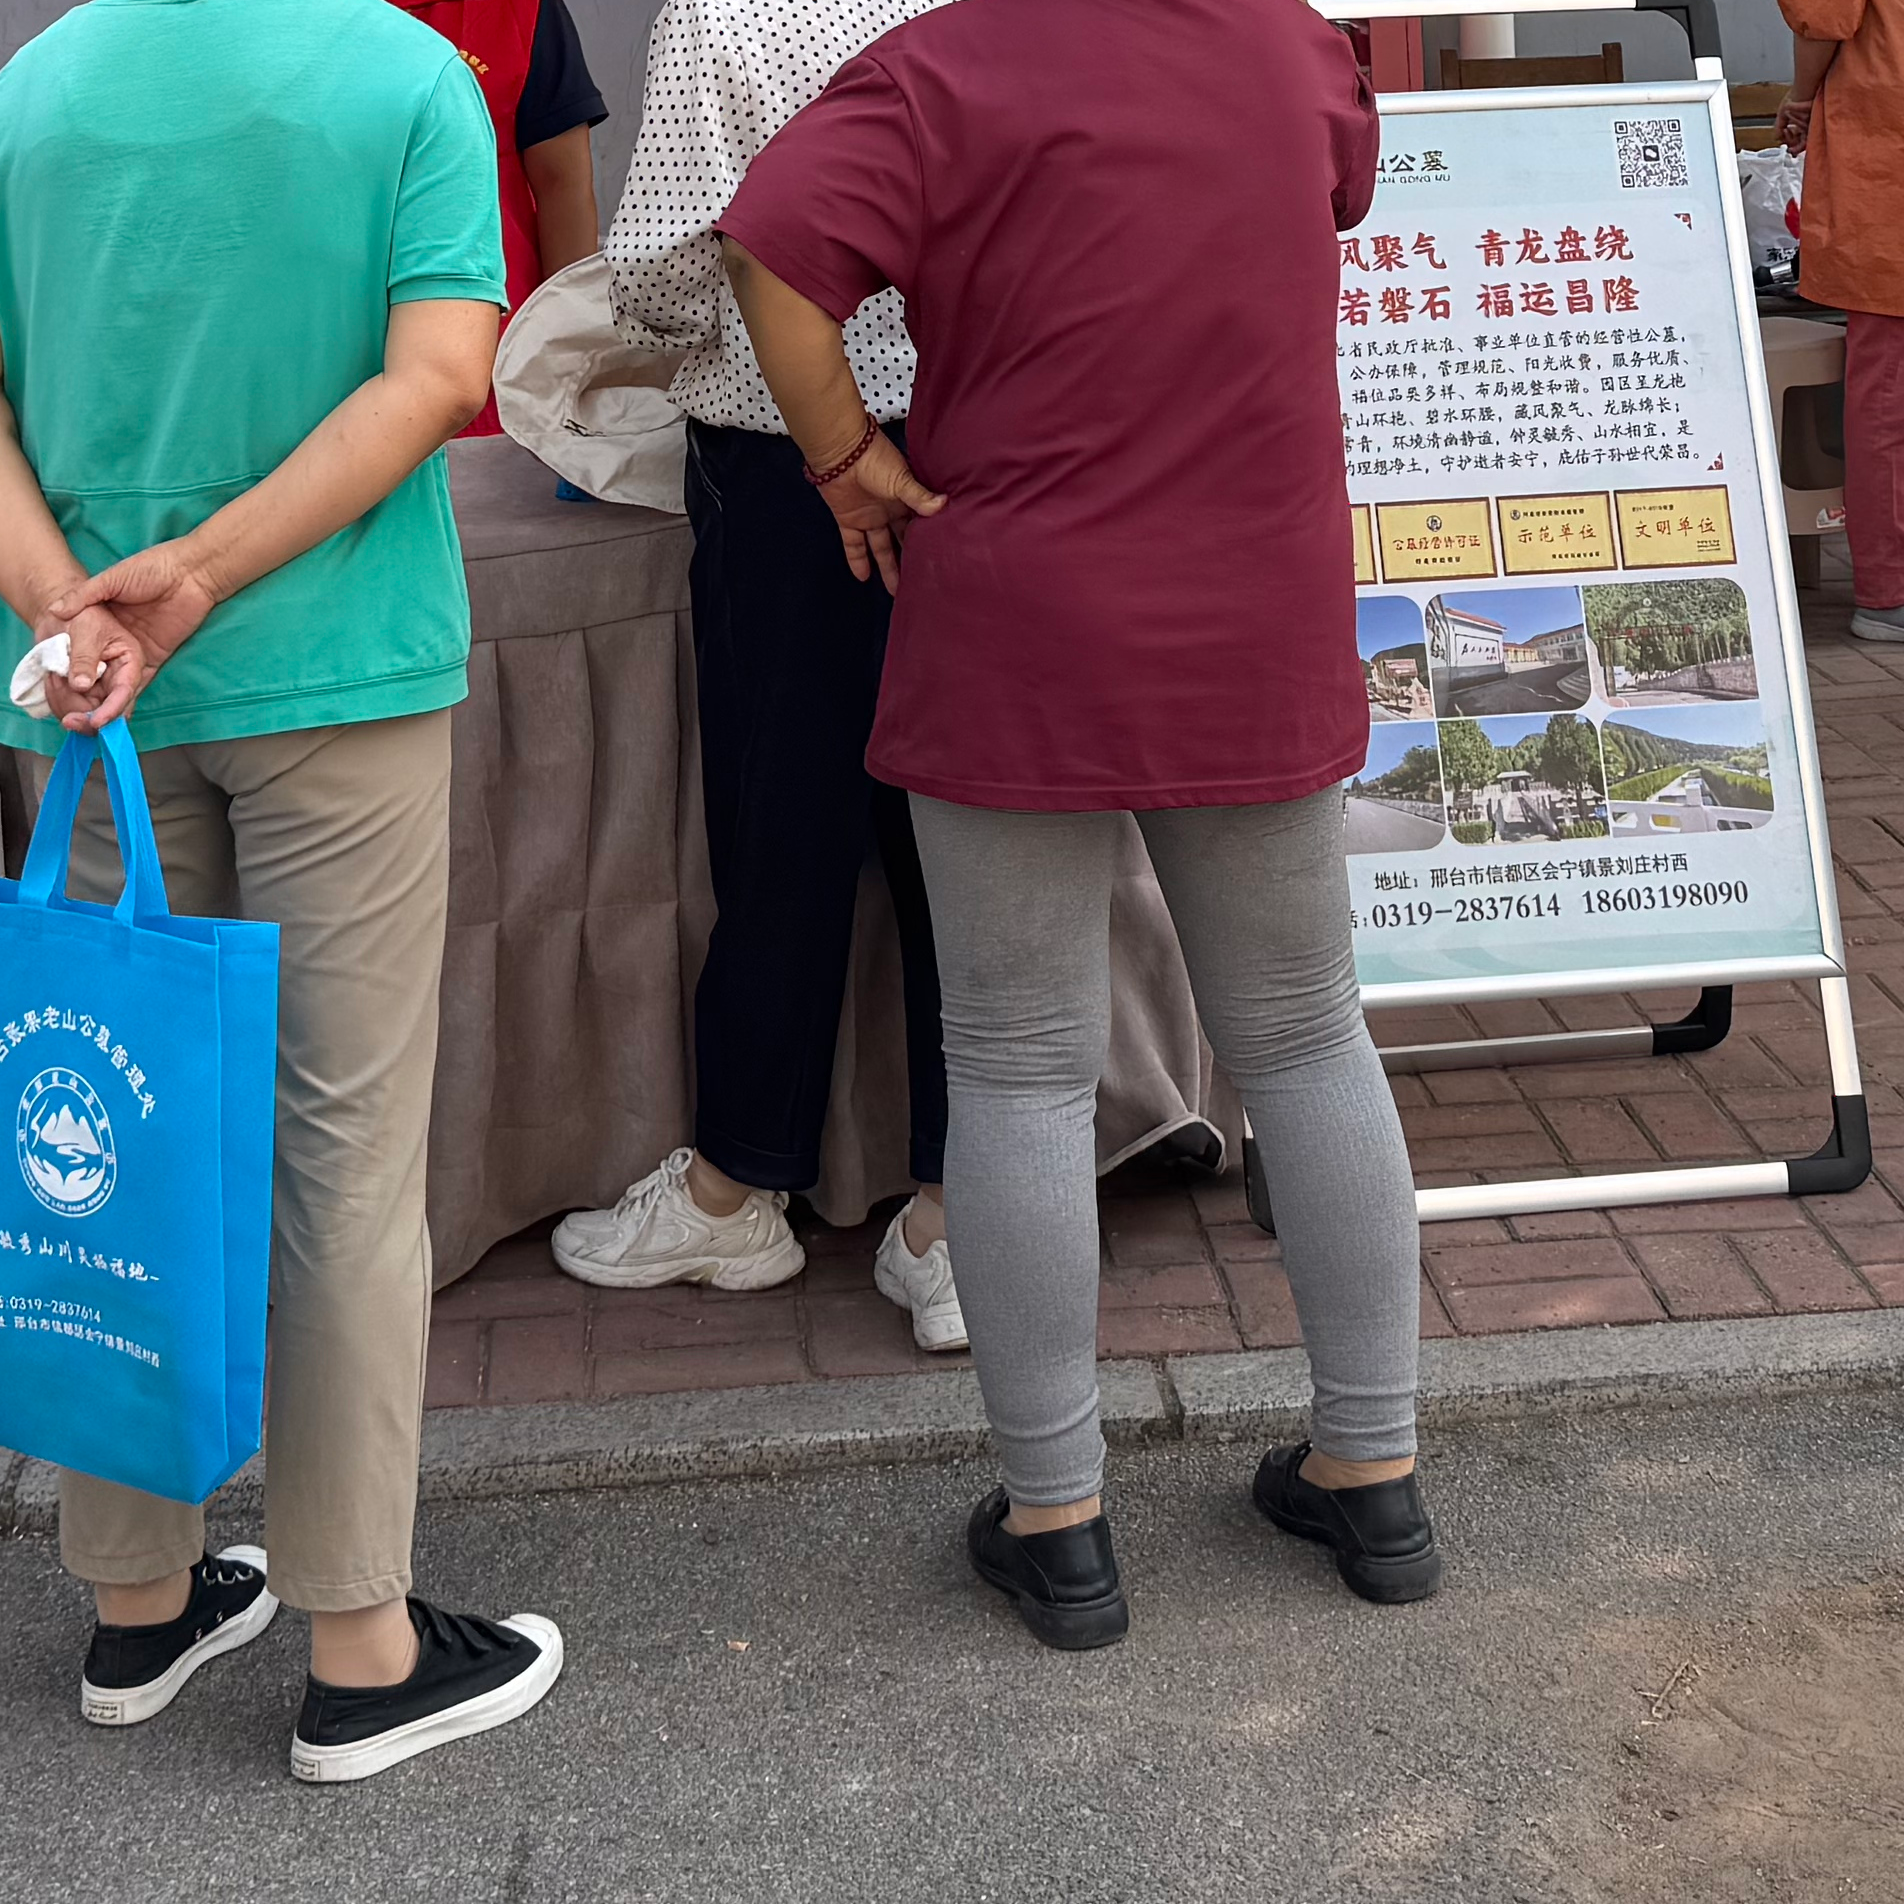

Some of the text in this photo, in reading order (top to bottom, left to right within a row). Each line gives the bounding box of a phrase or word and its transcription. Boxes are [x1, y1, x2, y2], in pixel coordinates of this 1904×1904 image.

[1475, 224, 1635, 269] 青龙盘绕
[1475, 274, 1642, 320] 福运昌隆
[1517, 522, 1597, 544] 示范单位
[1634, 515, 1716, 539] 文明单位
[1582, 879, 1749, 916] 18603198090
